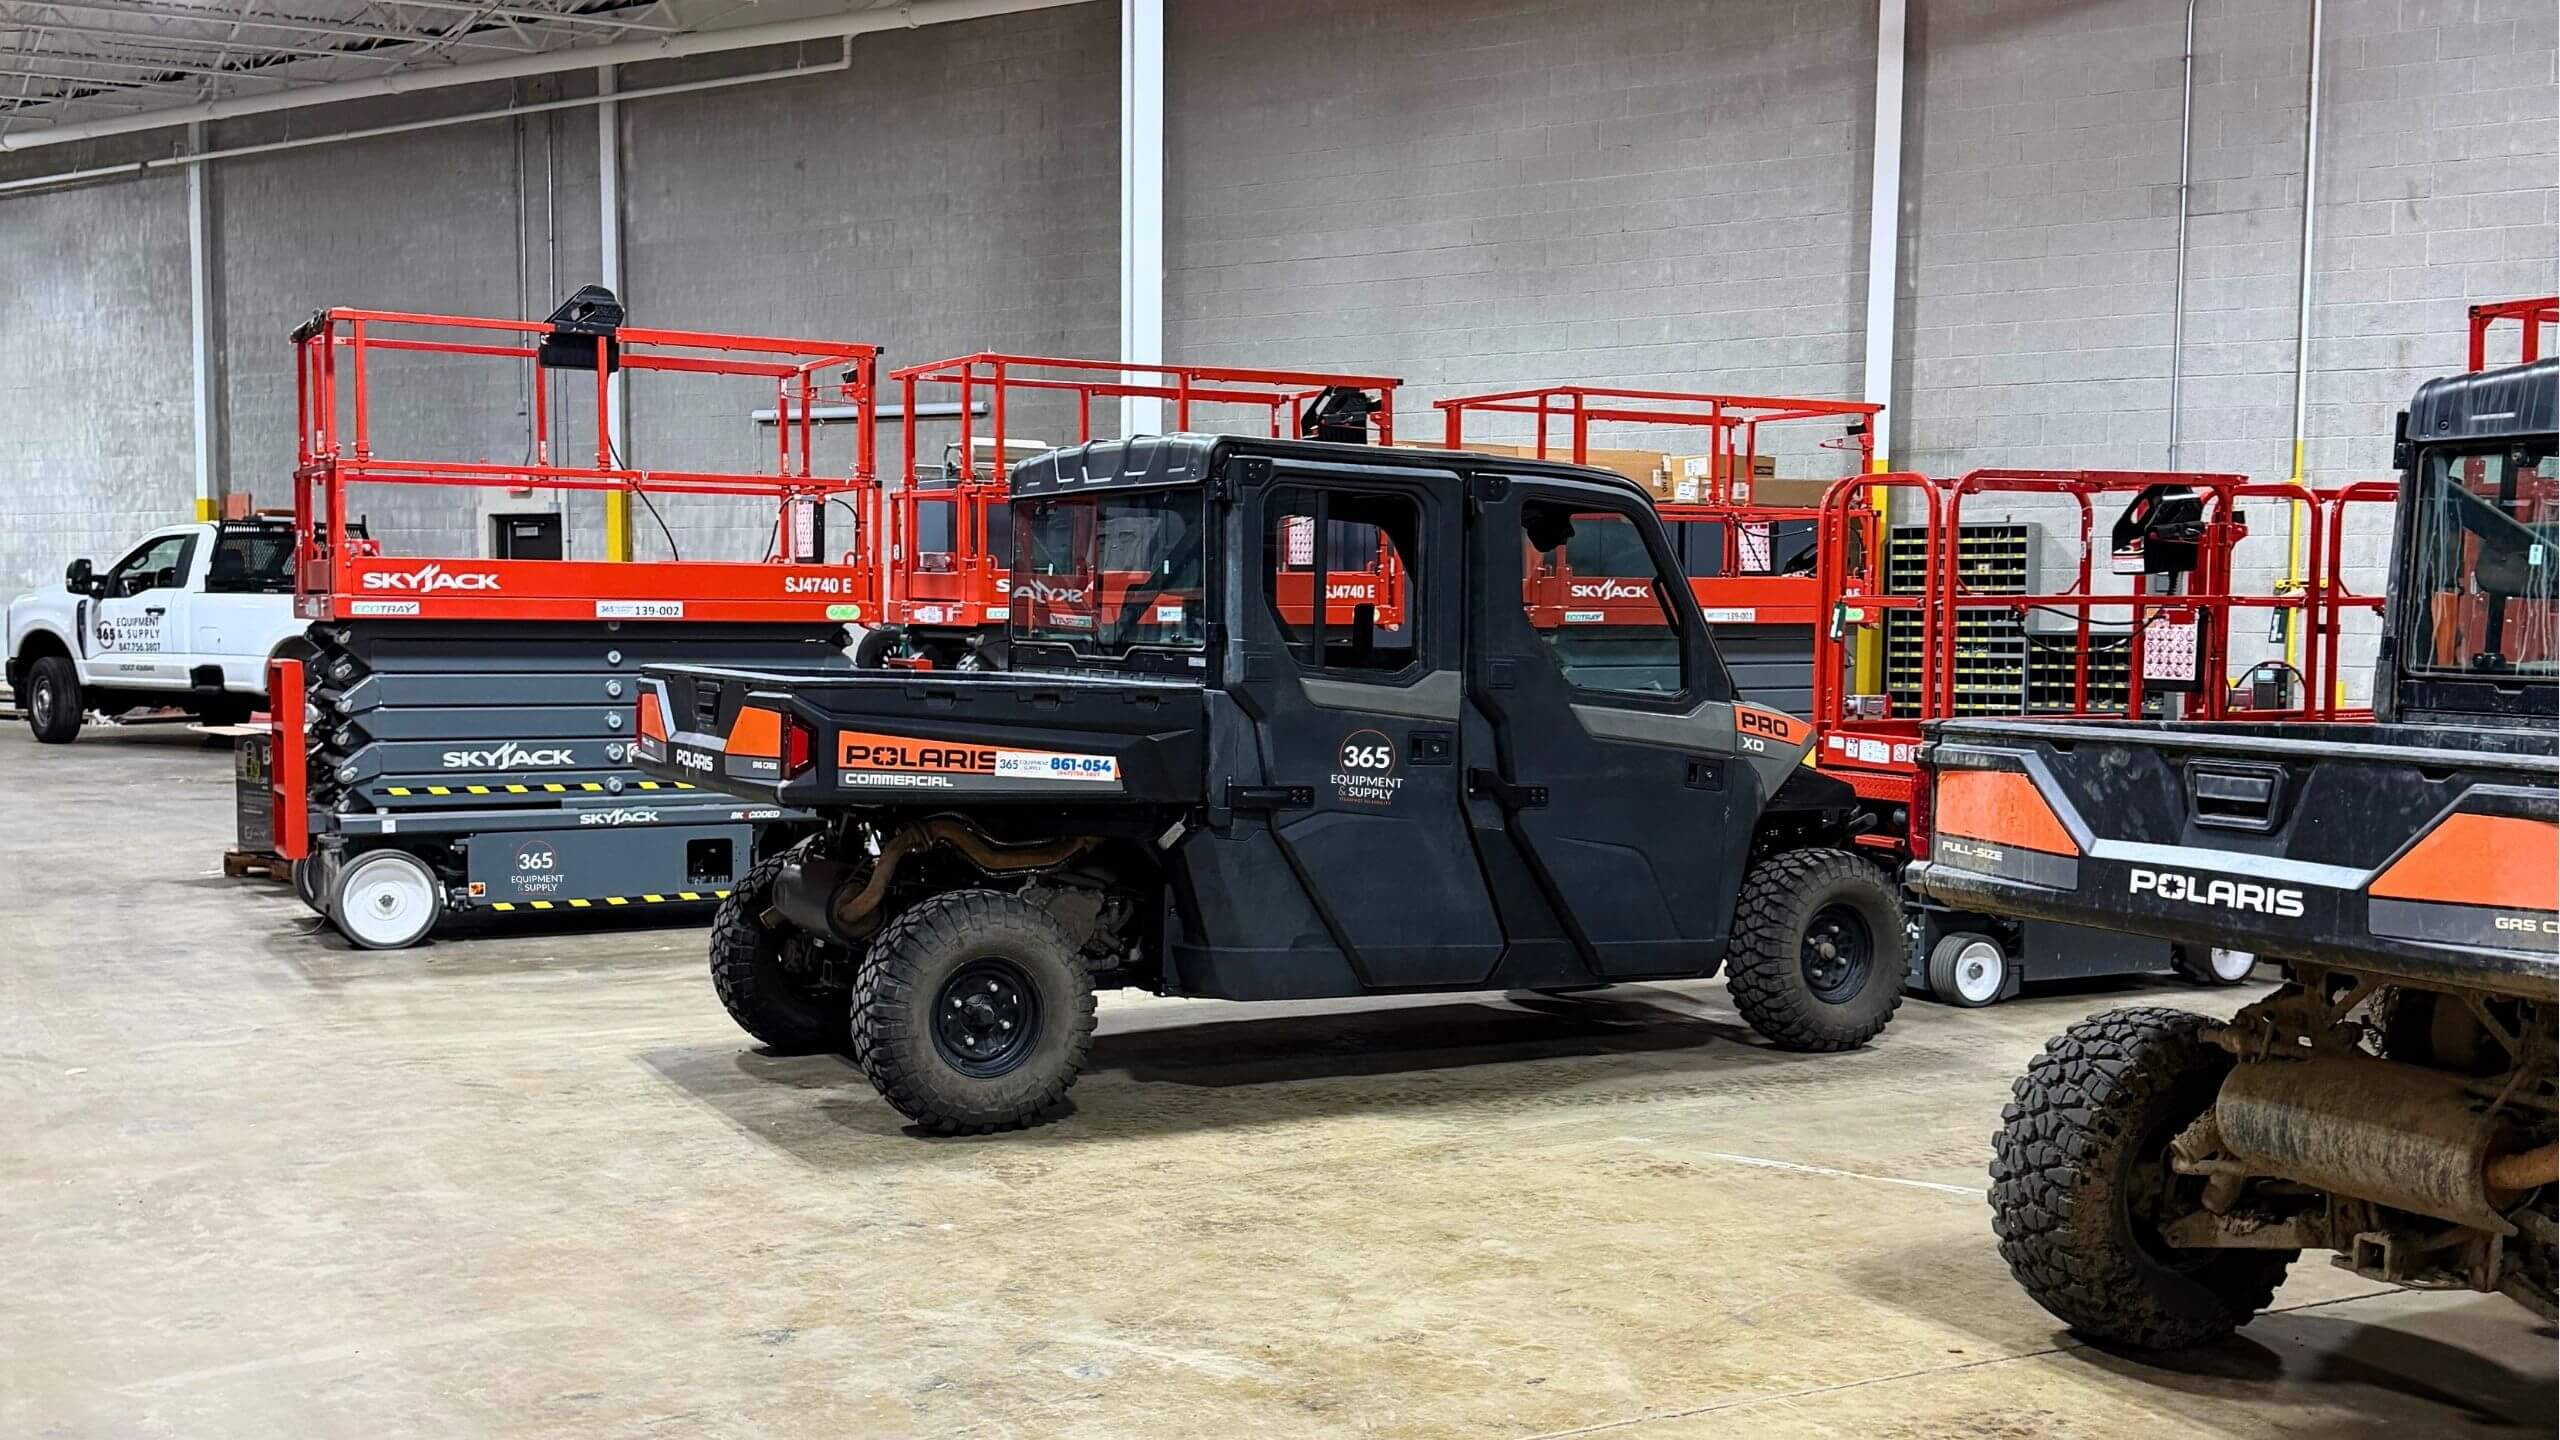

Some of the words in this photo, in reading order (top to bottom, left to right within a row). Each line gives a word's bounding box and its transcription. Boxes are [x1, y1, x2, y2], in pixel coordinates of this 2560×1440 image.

[362, 563, 501, 593] SKYJACK
[785, 576, 839, 594] SJ4740
[842, 577, 852, 594] E
[1367, 584, 1375, 598] E
[1571, 578, 1649, 600] SKYJACK
[354, 604, 417, 614] ECOTRAY
[635, 606, 680, 616] 139-002
[116, 617, 160, 627] EQUIPMENT
[96, 627, 115, 640] 365
[127, 629, 160, 639] SUPPLY
[1741, 711, 1789, 737] PRO
[1742, 736, 1764, 752] XD
[442, 742, 576, 770] SKYJACK
[676, 749, 714, 772] POLARIS
[846, 745, 996, 770] POLARIS
[1343, 745, 1390, 769] 365
[999, 758, 1019, 770] 365
[1050, 757, 1112, 772] 861-054
[845, 773, 954, 787] COMMERCIAL
[1330, 774, 1404, 789] EQUIPMENT
[1338, 785, 1346, 797] &
[1348, 786, 1393, 800] SUPPLY
[580, 808, 659, 825] SKYJACK
[1942, 841, 2003, 861] FULL-SIZE
[519, 851, 553, 870] 365
[511, 874, 565, 884] EQUIPMENT
[524, 883, 558, 892] SUPPLY
[2129, 868, 2305, 918] POLARIS
[2495, 917, 2537, 932] GAS
